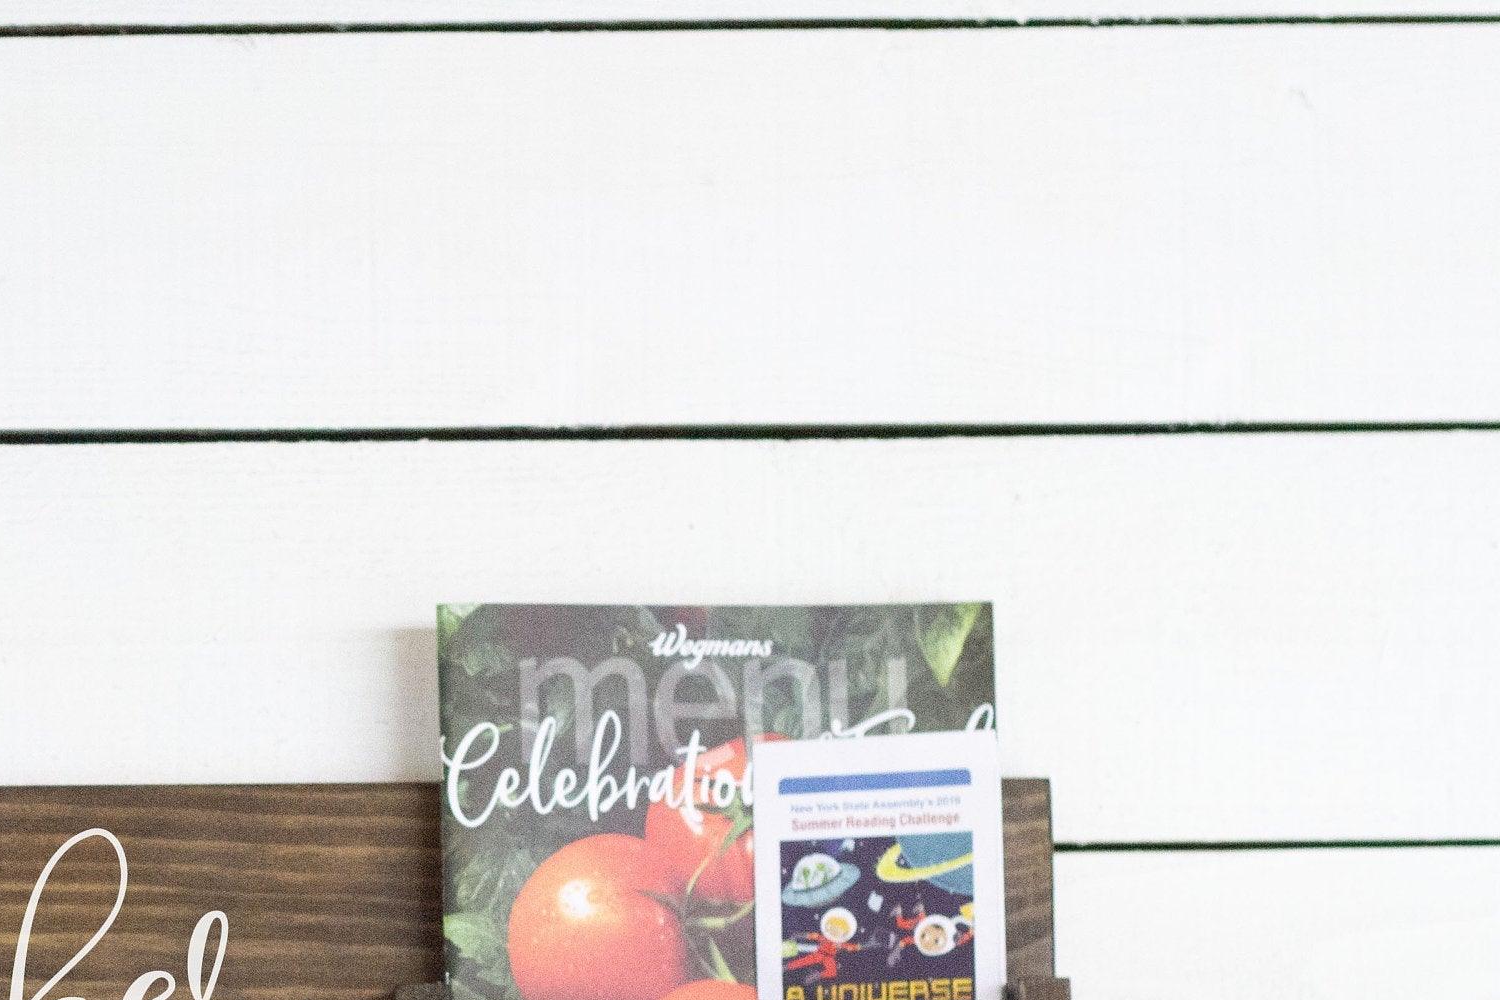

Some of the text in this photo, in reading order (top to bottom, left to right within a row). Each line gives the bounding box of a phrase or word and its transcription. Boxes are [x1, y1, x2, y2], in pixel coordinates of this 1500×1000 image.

[649, 624, 774, 670] Wegmans
[519, 656, 908, 765] menu
[790, 803, 813, 814] New
[816, 802, 840, 813] York
[842, 801, 870, 812] State
[791, 811, 961, 832] Summer Reading Challenge
